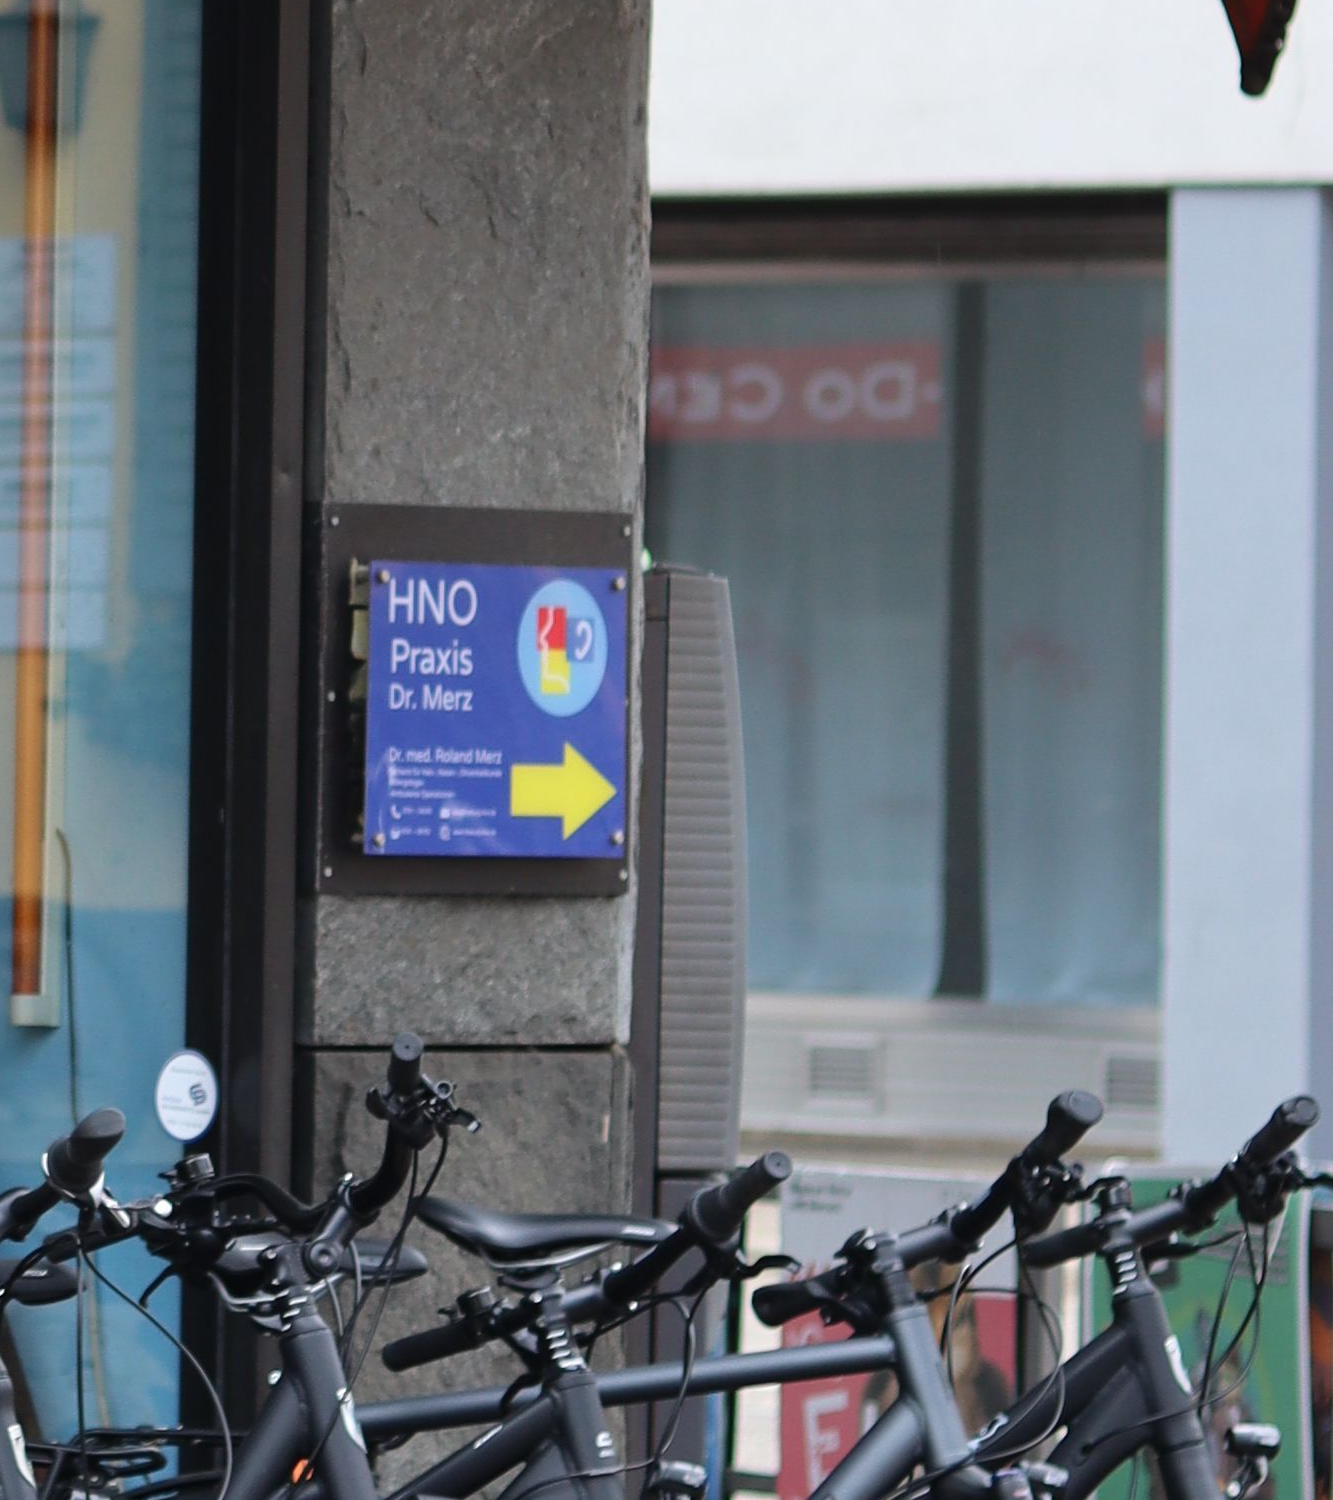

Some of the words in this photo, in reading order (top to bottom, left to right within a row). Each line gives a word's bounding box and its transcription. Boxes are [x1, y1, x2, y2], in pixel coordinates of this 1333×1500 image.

[388, 579, 478, 627] HNO
[390, 638, 473, 677] Praxis
[389, 683, 418, 711] Dr.
[423, 684, 474, 712] Merz
[435, 747, 473, 764] Roland
[475, 749, 502, 765] Merz
